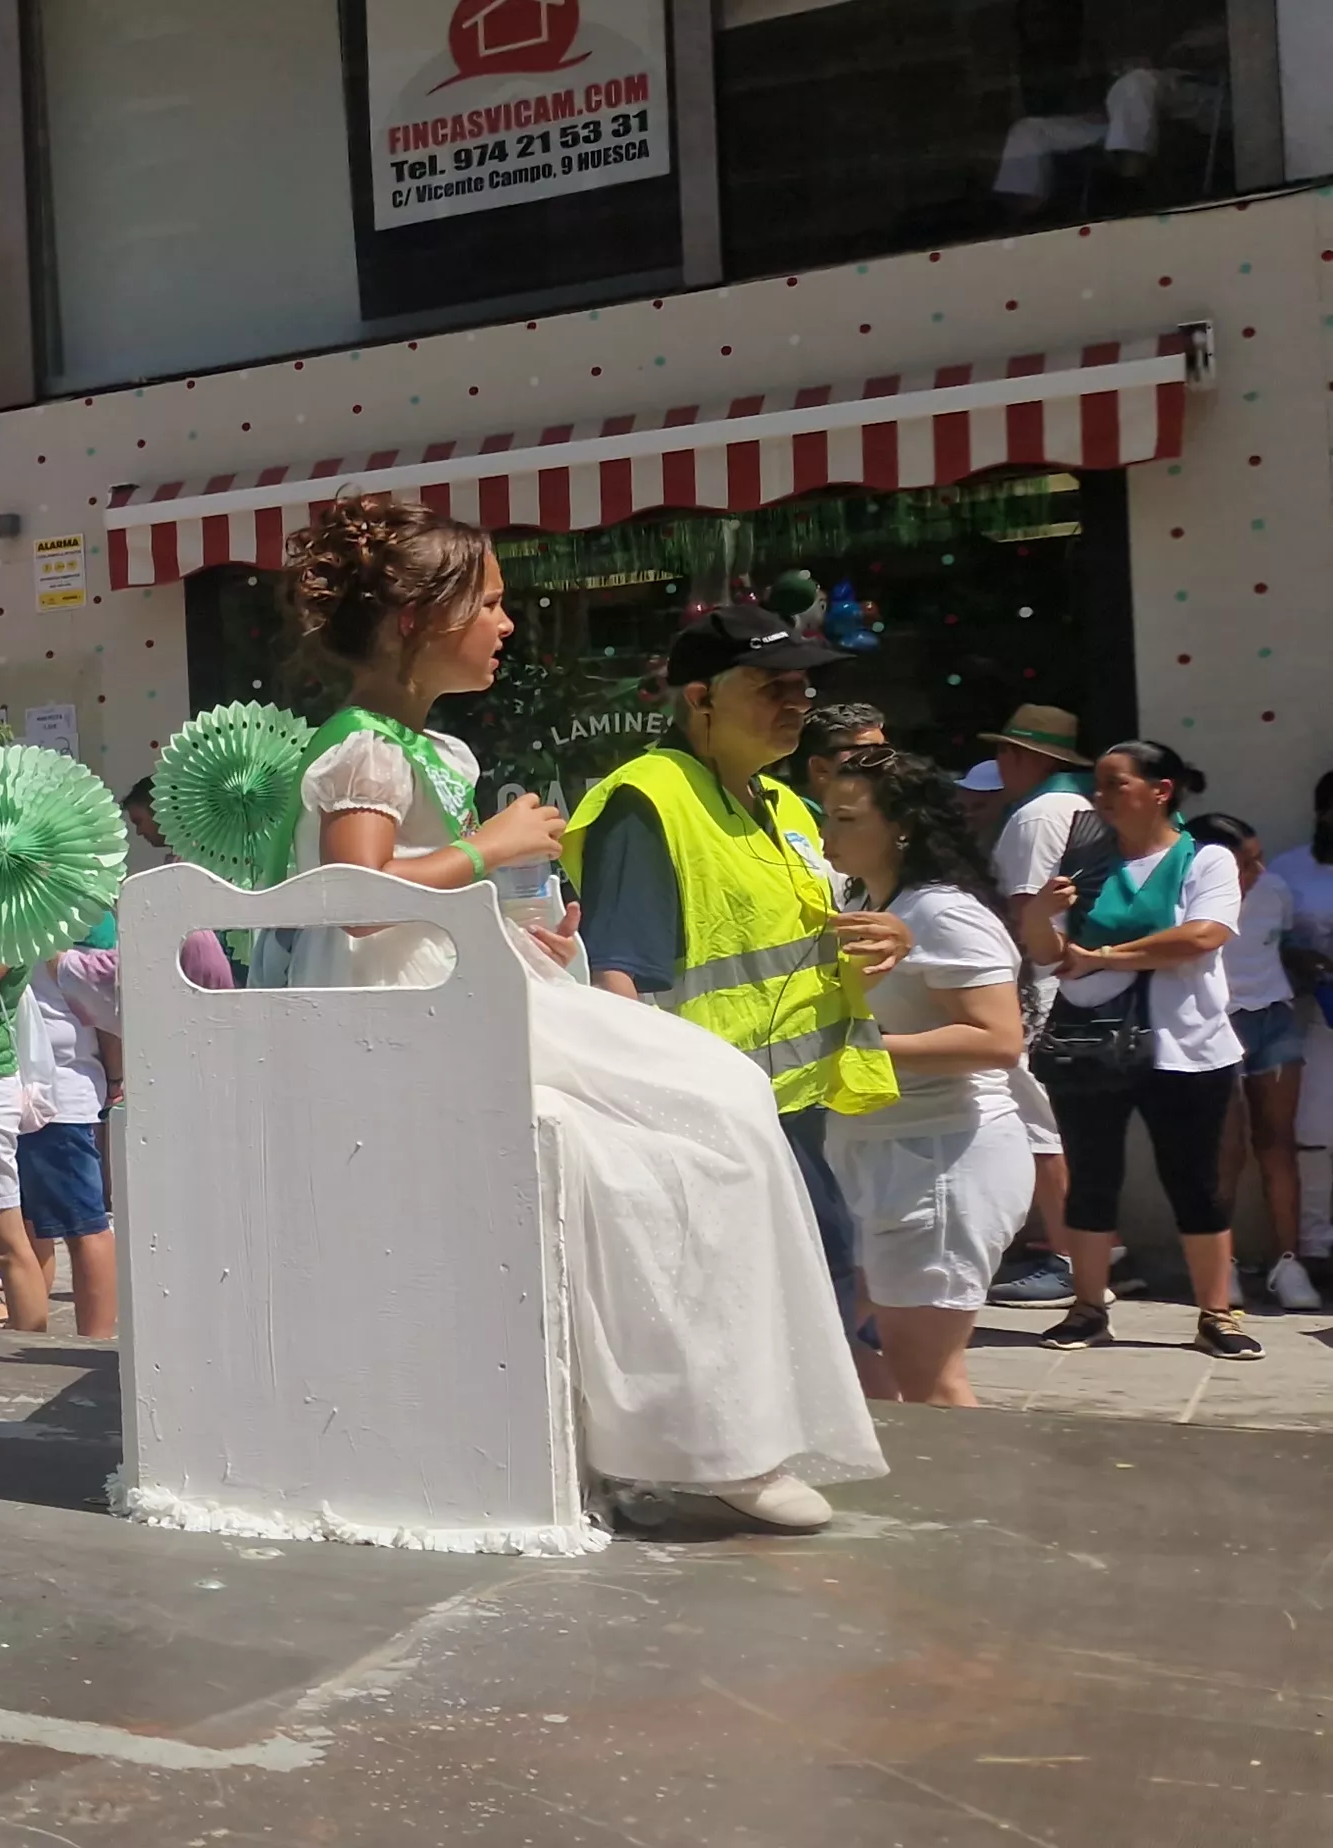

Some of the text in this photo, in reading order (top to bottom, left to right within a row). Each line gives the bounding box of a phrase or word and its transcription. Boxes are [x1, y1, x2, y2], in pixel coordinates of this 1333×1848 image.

[388, 73, 649, 155] FINCASVICAM.COM
[390, 109, 649, 183] Tel. 974 21 53 31
[391, 139, 650, 209] C/ Vicente Campo, 9 HUESCA
[37, 538, 80, 552] ALARMA
